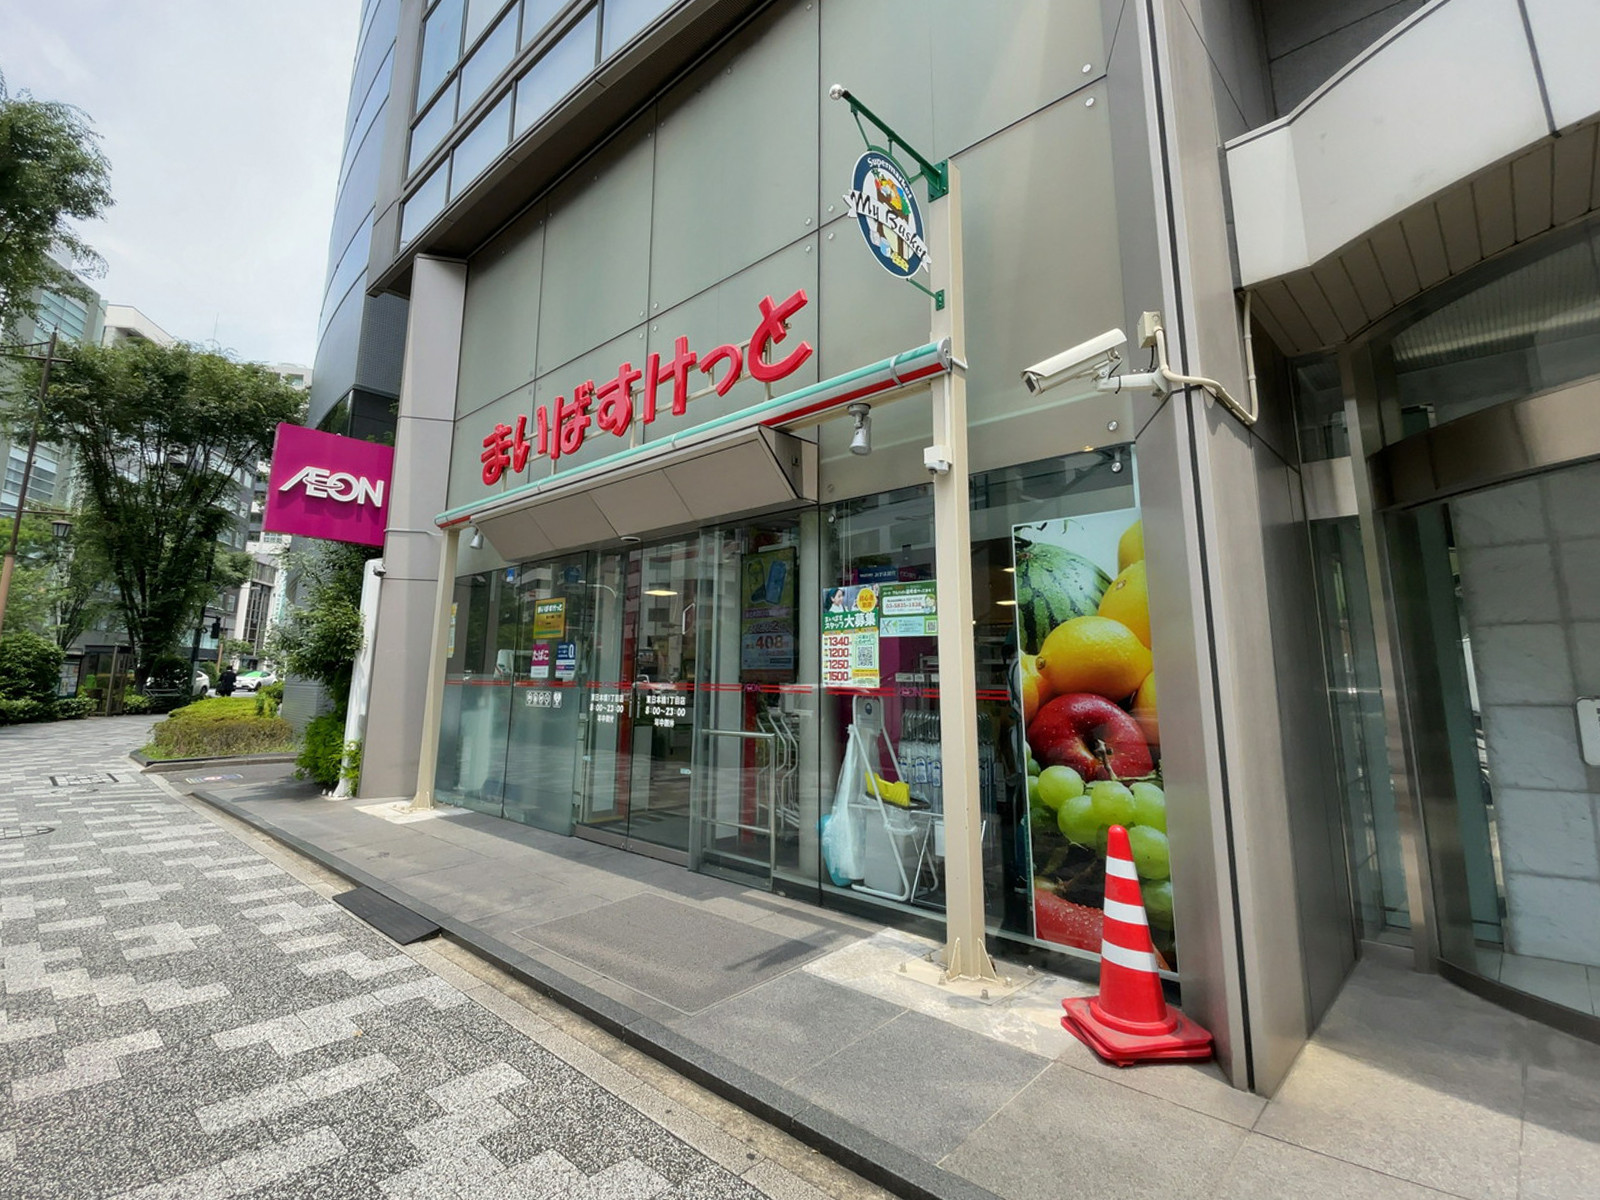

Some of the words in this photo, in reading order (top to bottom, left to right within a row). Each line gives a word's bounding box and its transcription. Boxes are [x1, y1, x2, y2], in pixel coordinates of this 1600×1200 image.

[867, 157, 912, 199] Supermarket
[850, 190, 879, 222] My
[480, 287, 814, 486] まいばすけっと
[278, 465, 385, 508] AEON
[844, 612, 876, 628] 大募集
[755, 634, 783, 649] 408
[828, 636, 850, 646] 1340
[532, 648, 549, 661] たばこ
[828, 647, 850, 657] 1200
[828, 659, 850, 669] 1250
[828, 671, 849, 681] 1500
